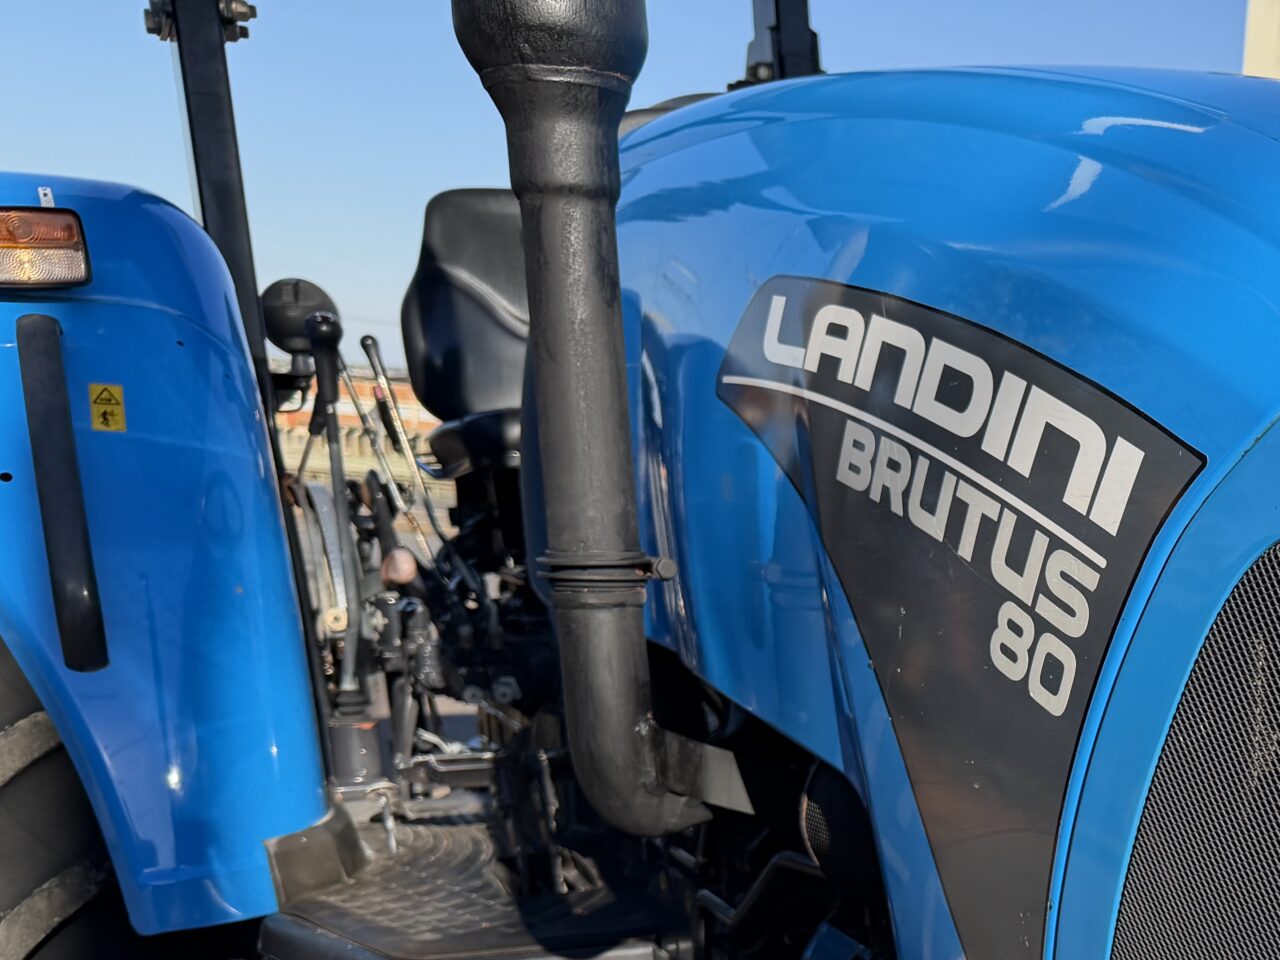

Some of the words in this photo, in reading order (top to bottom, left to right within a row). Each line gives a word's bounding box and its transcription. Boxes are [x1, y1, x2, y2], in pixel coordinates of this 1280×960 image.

[763, 296, 1145, 537] LANDINI
[836, 420, 1100, 638] BRUTUS
[990, 601, 1077, 717] 80
